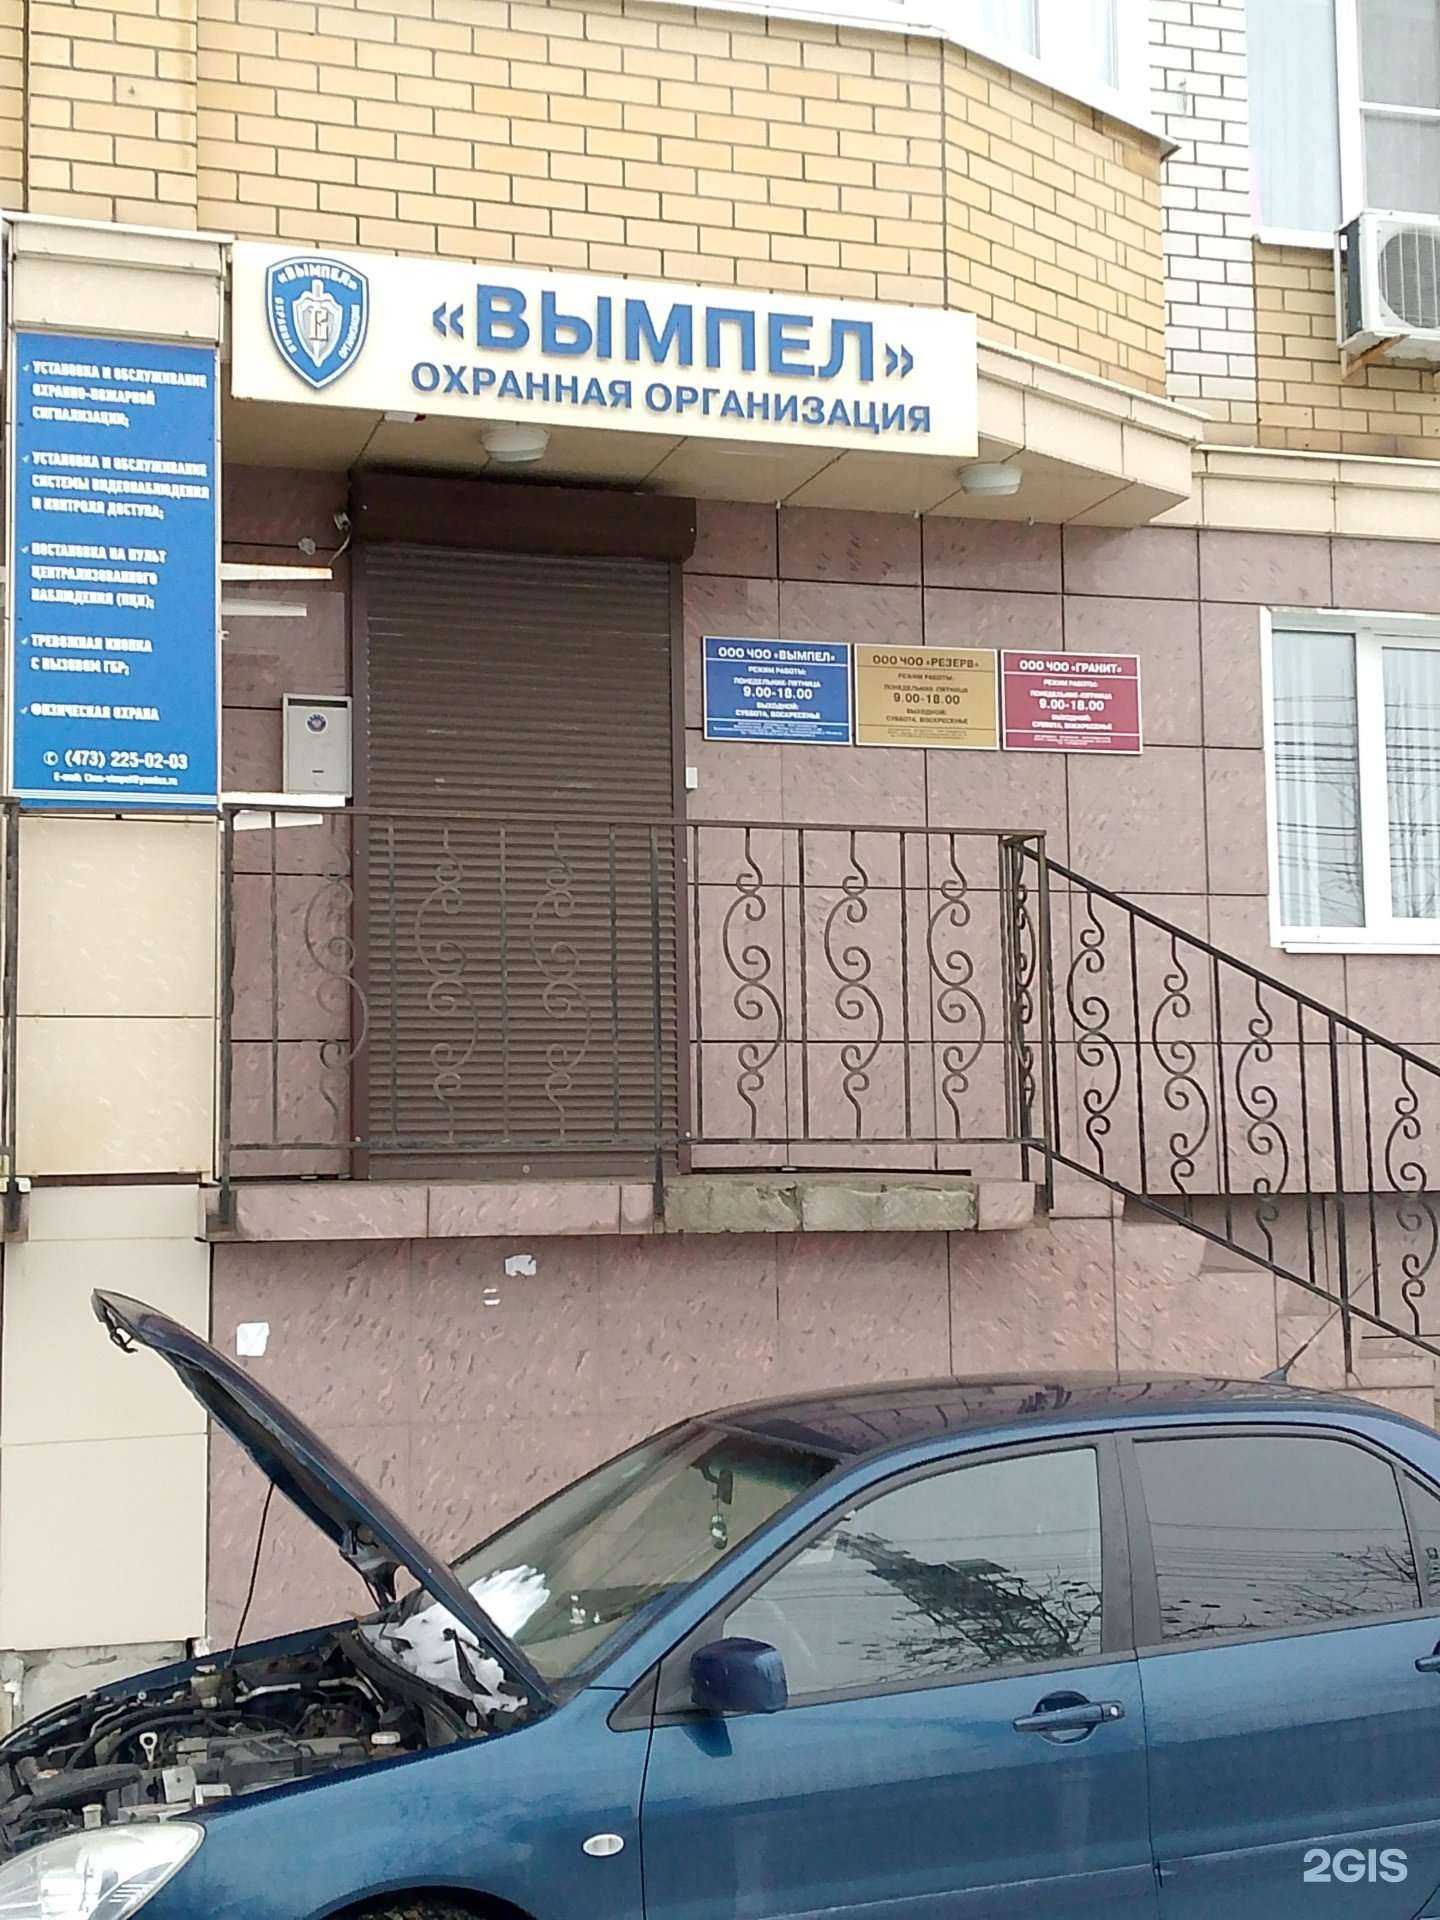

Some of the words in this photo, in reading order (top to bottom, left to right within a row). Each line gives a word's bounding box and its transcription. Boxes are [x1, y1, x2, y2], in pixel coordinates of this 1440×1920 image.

[432, 283, 914, 382] «ВЫМПЕЛ»
[32, 360, 100, 379] УСТАНОВКА
[101, 366, 112, 380] И
[113, 367, 208, 389] ОБСЛУЖИВАНИЕ
[411, 361, 632, 409] ОХРАННАЯ
[645, 382, 931, 435] ОРГАНИЗАЦИЯ
[31, 450, 100, 470] УСТАНОВКА
[101, 456, 112, 470] И
[113, 457, 208, 478] ОБСЛУЖИВАНИЕ
[31, 474, 90, 491] СИСТЕМЫ
[31, 633, 103, 651] ТРЕВОЖНАЯ
[104, 637, 153, 653] КНОПКА
[718, 646, 745, 659] ООО
[746, 648, 772, 660] ЧОО
[872, 654, 898, 665] ООО
[899, 656, 924, 667] ЧОО
[41, 657, 101, 673] ВЫЗОВОМ
[1019, 659, 1045, 671] ООО
[1046, 660, 1070, 673] ЧОО
[1071, 662, 1123, 675] «ГРАНИТ»
[742, 685, 813, 700] 9.00-18.00
[30, 702, 111, 720] ФИЗИЧЕСКАЯ
[112, 706, 161, 721] ОХРАНА
[64, 749, 106, 769] (473)
[110, 751, 189, 770] 225-02-03
